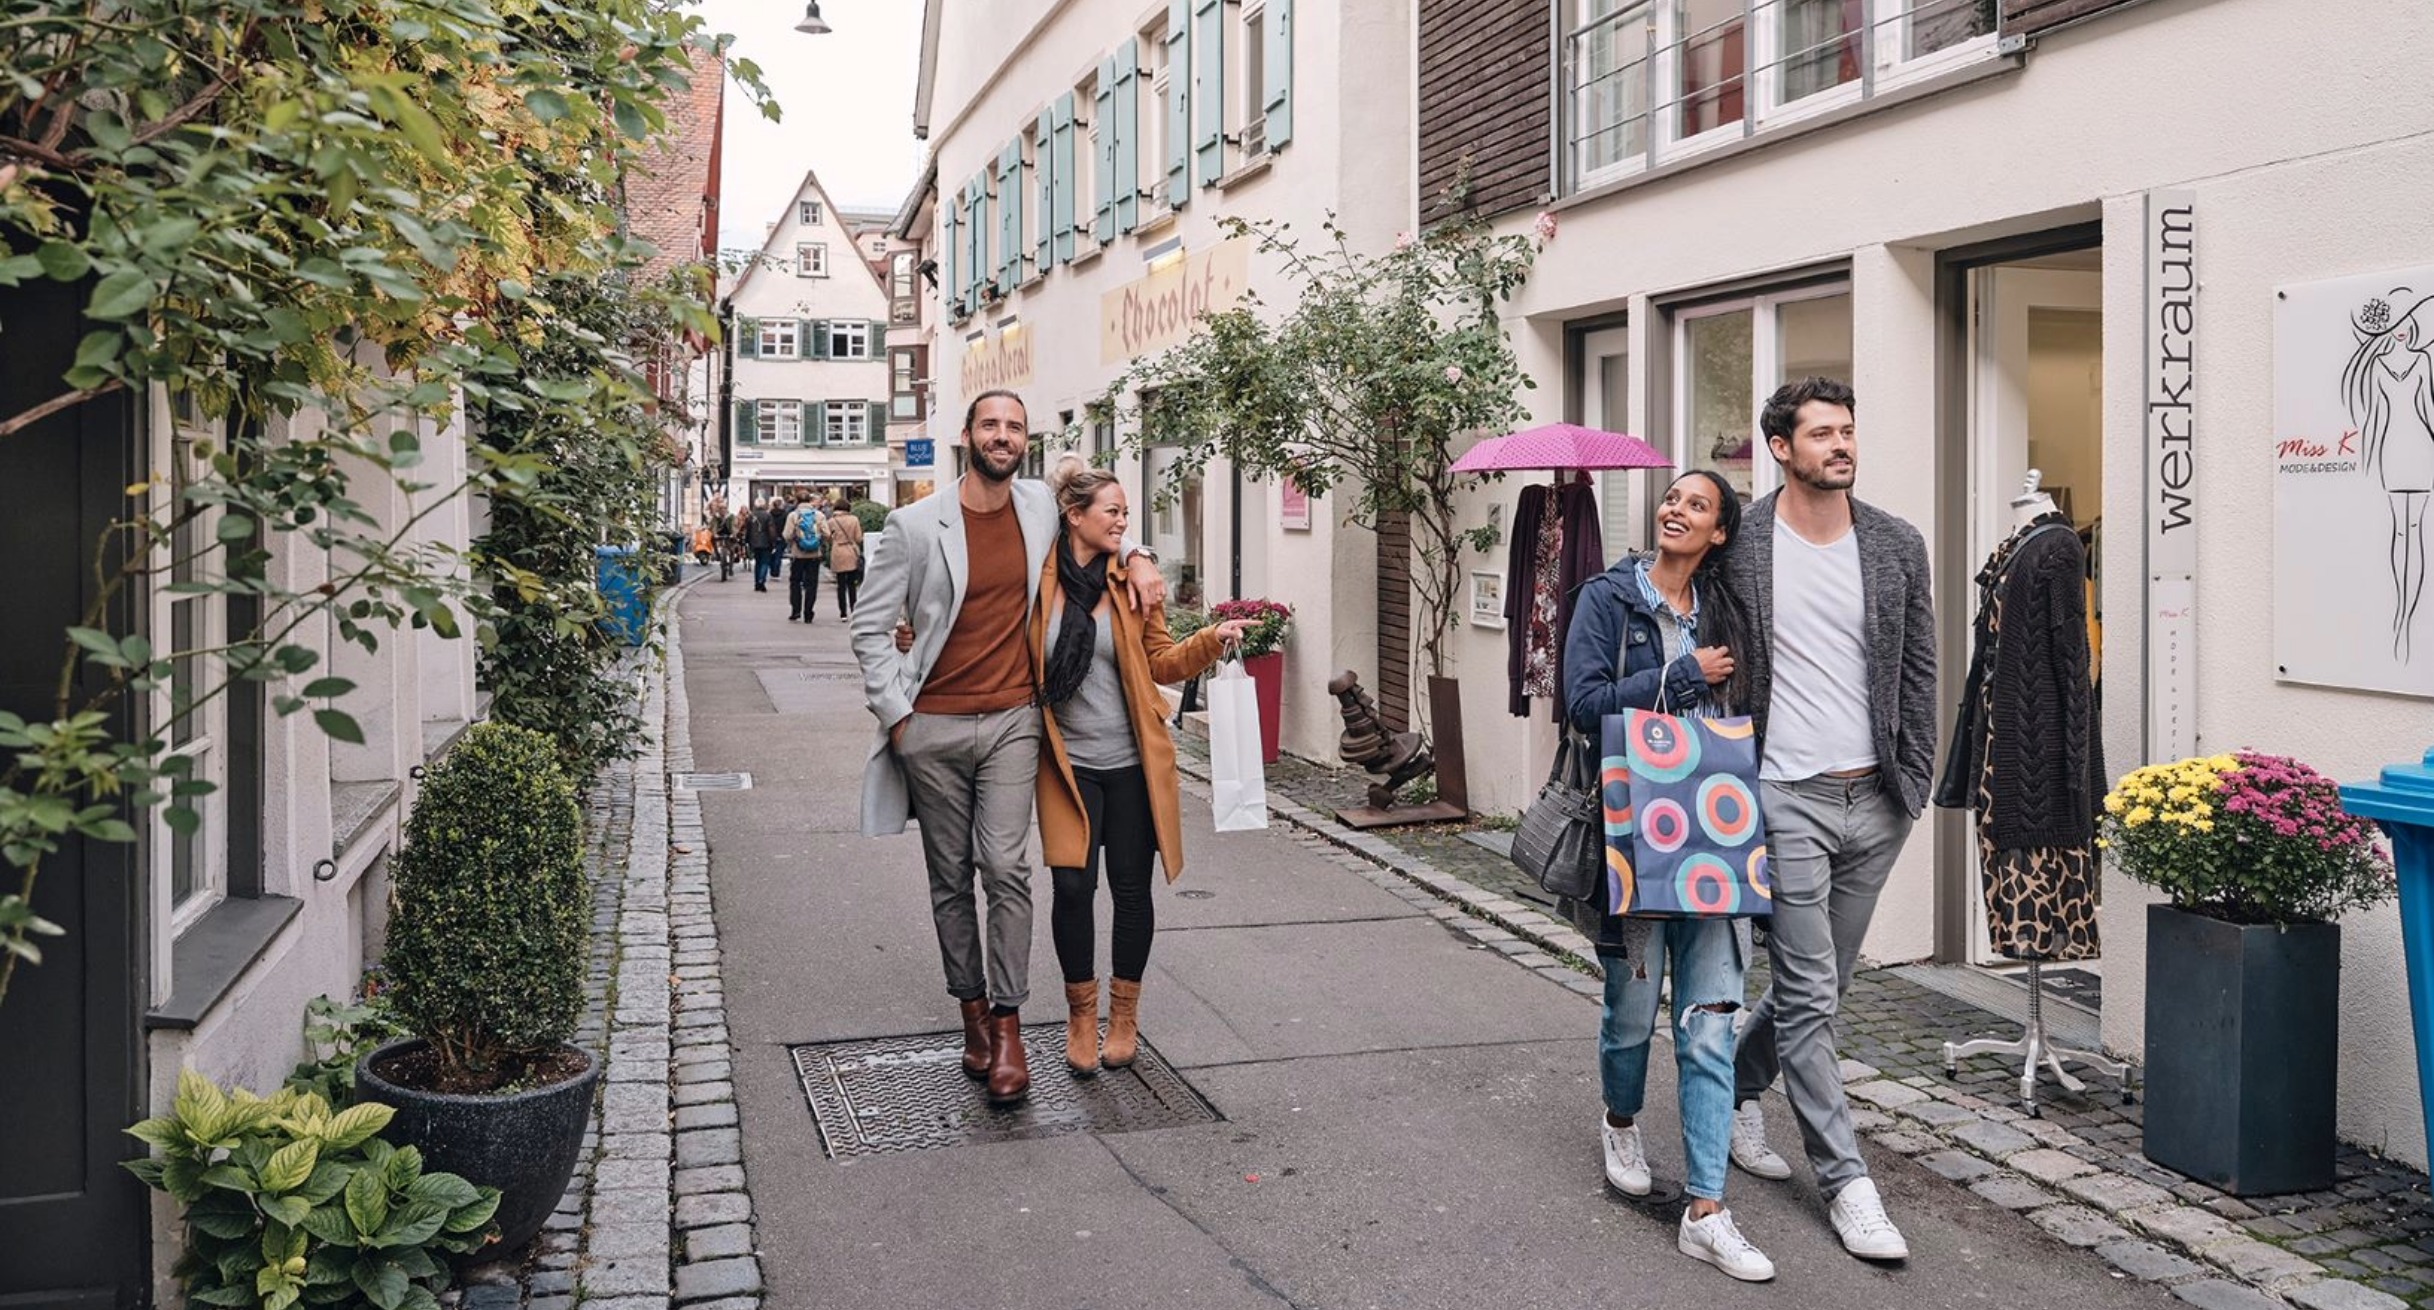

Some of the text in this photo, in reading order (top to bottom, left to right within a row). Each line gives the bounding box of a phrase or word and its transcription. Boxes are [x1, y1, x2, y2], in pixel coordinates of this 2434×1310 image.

[1122, 251, 1214, 353] Chocolat
[2149, 204, 2193, 534] werkraum
[2276, 431, 2359, 459] Miss K
[2279, 462, 2357, 474] MODE&DESIGN
